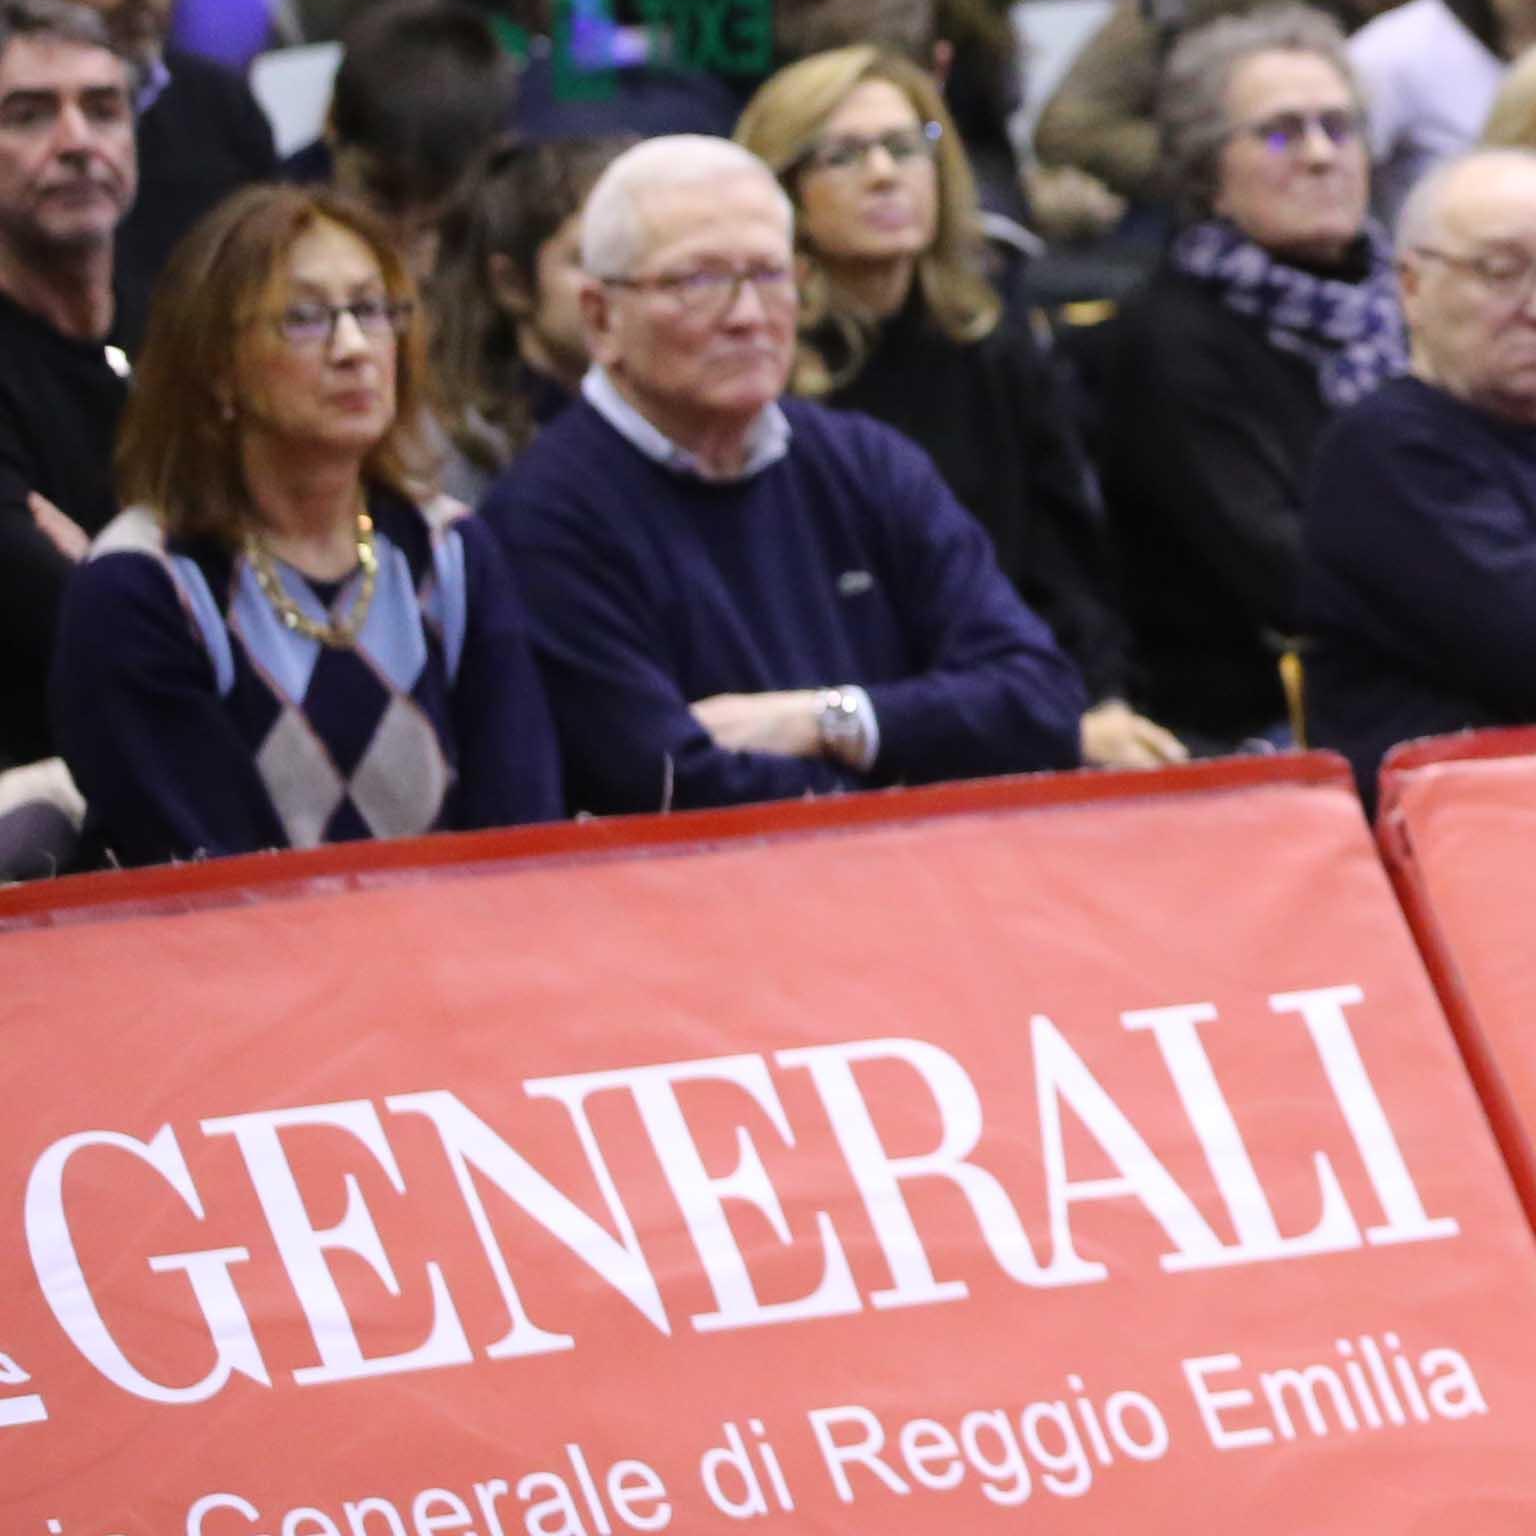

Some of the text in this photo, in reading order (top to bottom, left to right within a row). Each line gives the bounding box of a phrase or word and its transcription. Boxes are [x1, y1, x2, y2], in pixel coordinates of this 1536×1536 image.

[23, 984, 1461, 1406] GENERALI
[700, 1418, 796, 1519] di
[807, 1373, 1169, 1506] Reggio
[1181, 1330, 1489, 1449] Emilia
